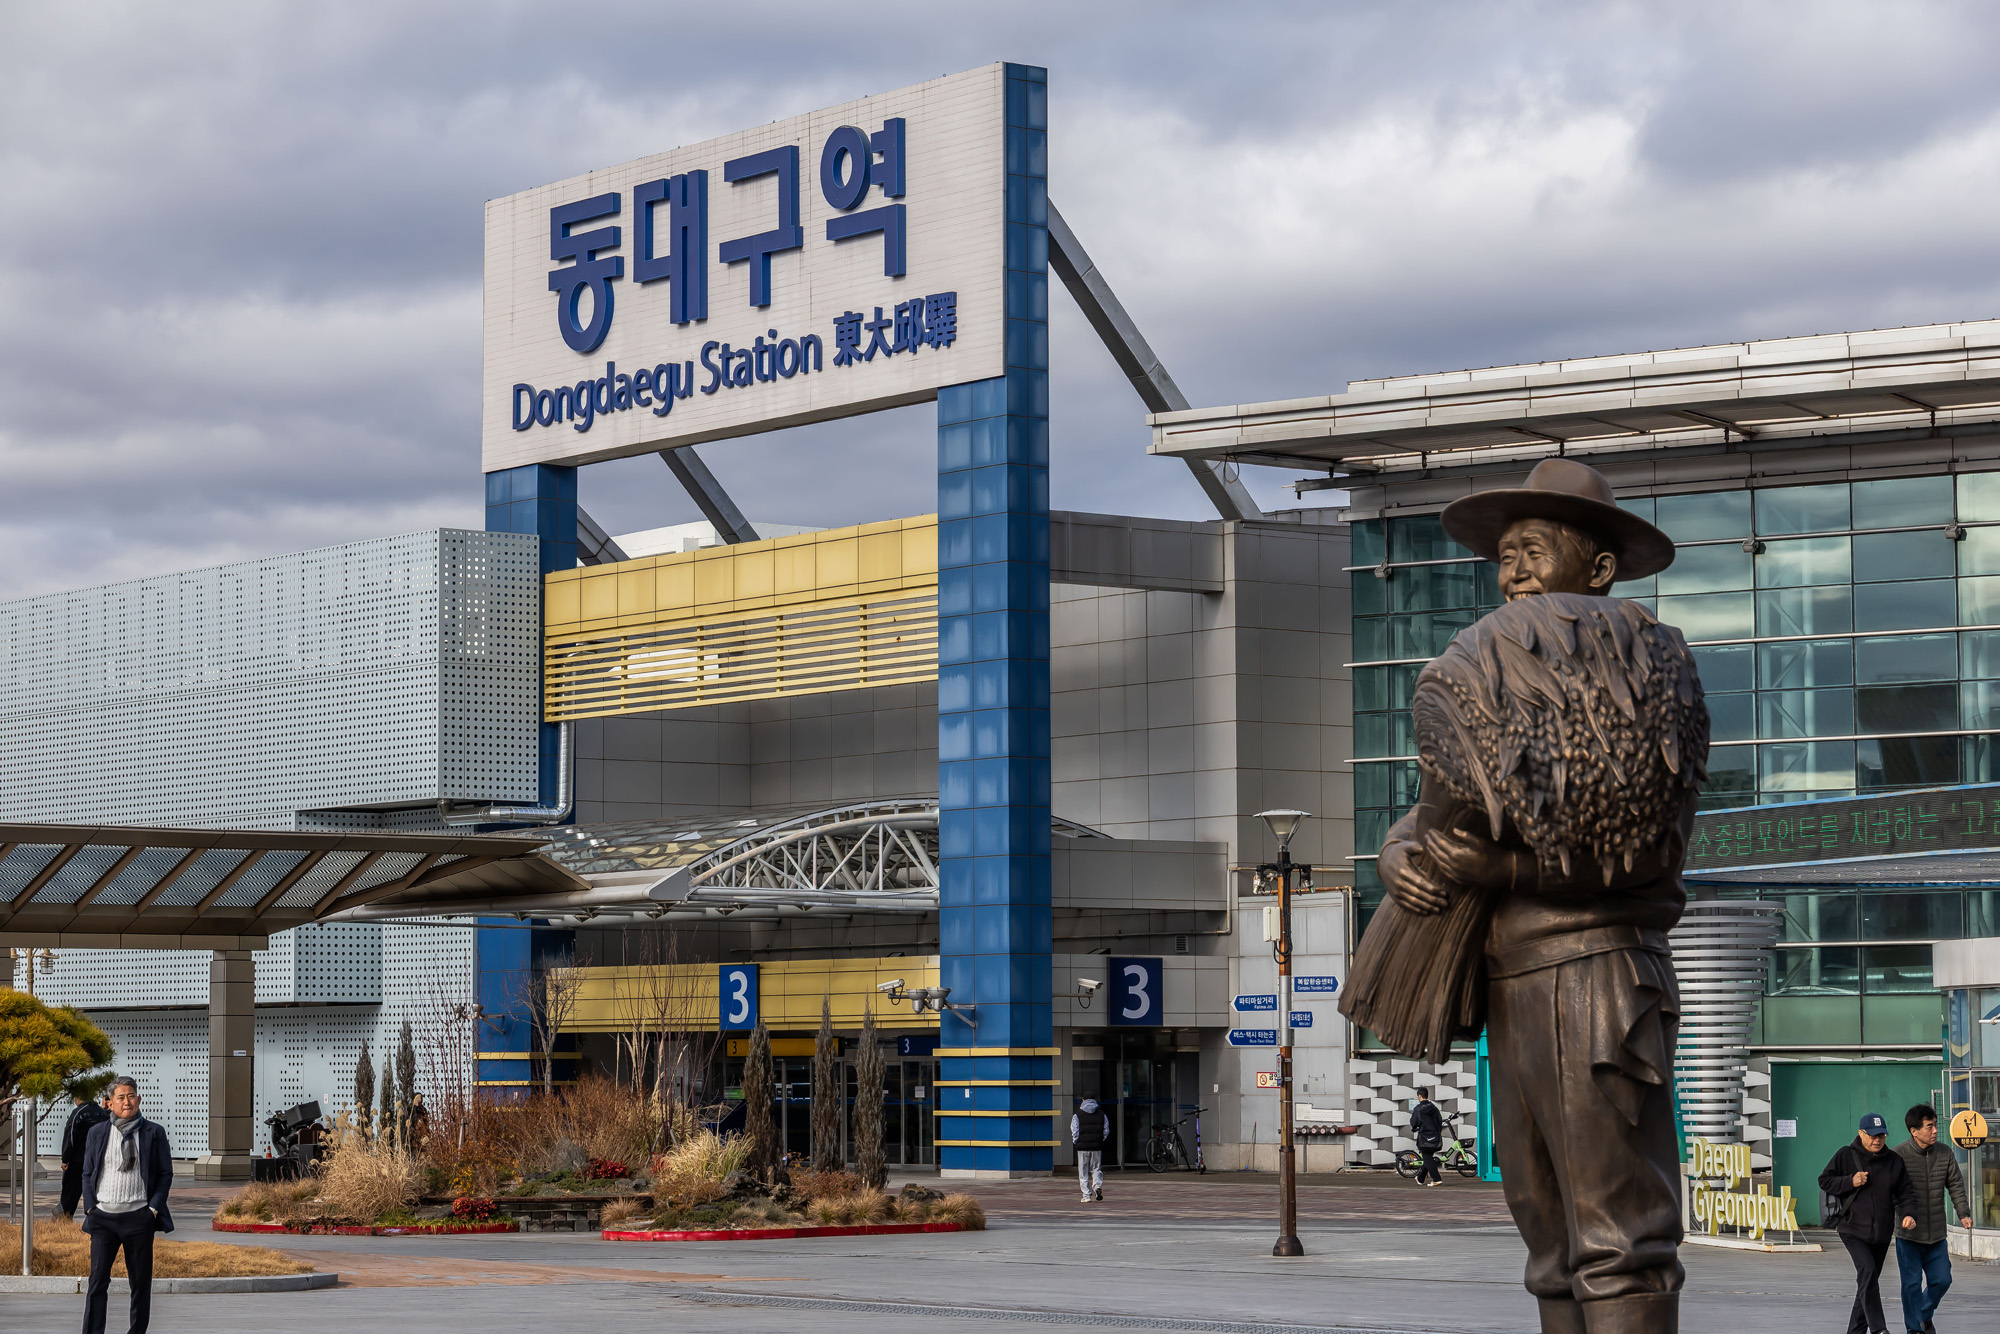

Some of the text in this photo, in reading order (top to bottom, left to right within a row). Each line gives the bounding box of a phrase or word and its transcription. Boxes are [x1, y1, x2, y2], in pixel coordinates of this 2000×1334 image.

[548, 117, 906, 352] 동대구역
[833, 291, 958, 367] 東大邱驛
[512, 329, 822, 432] Dongdaegu Station
[1686, 815, 1840, 860] 소중립포인트를
[1850, 805, 1939, 844] 지급하는
[728, 971, 748, 1025] 3
[1122, 964, 1151, 1019] 3
[1239, 996, 1274, 1005] 파티마삼거리
[732, 1041, 738, 1055] 3
[904, 1038, 910, 1053] 3
[1693, 1138, 1751, 1189] Daegu
[1693, 1180, 1798, 1240] Gyeongbuk
